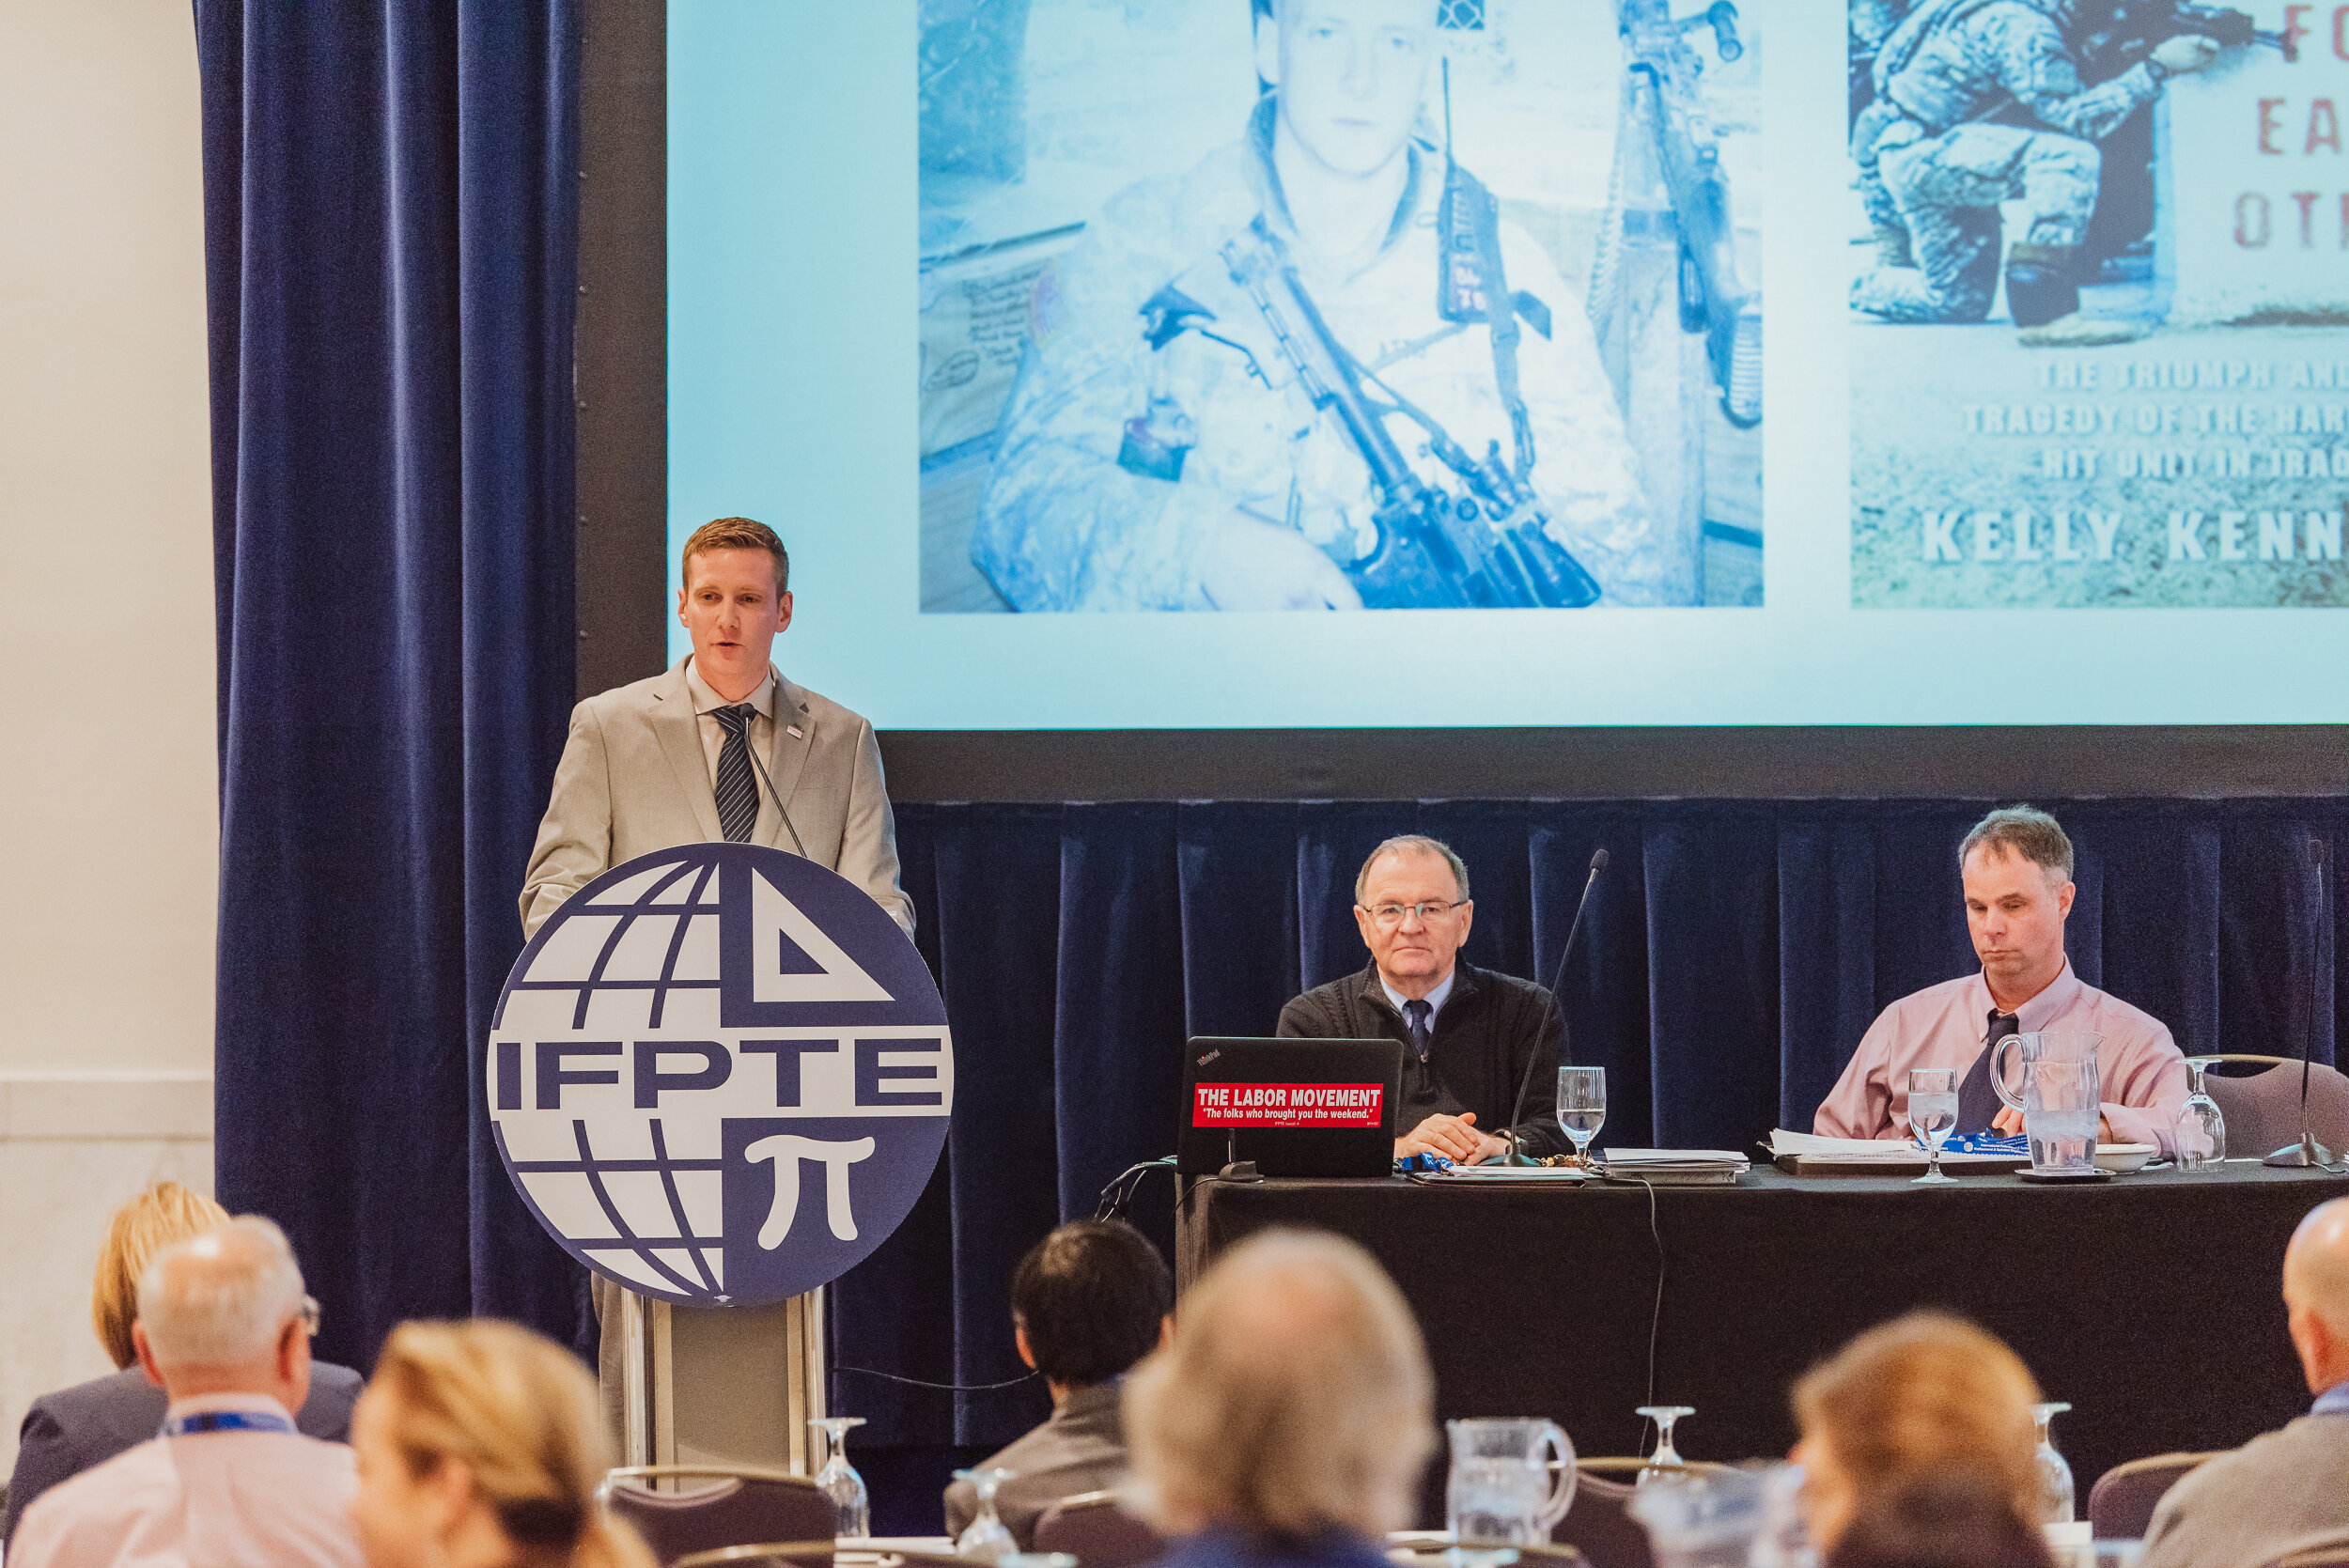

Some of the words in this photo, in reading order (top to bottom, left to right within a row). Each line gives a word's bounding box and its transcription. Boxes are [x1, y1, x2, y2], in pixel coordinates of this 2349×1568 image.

[2258, 98, 2341, 155] EA
[2233, 192, 2349, 250] OT
[2035, 360, 2097, 388] THE
[2116, 360, 2271, 389] TRIUMPH
[1963, 404, 2119, 433] TRAGEDY
[2137, 404, 2181, 433] OF
[2197, 404, 2257, 433] THE
[2118, 449, 2199, 478] UNIT
[2216, 449, 2251, 478] IN
[1922, 510, 2123, 561] KELLY
[2166, 510, 2343, 561] KENN
[496, 1037, 942, 1110] IFPTE
[1198, 1089, 1229, 1106] THE
[1234, 1089, 1286, 1106] LABOR
[1291, 1089, 1380, 1107] MOVEMENT
[1223, 1108, 1244, 1118] folks
[1246, 1109, 1263, 1118] who
[1265, 1108, 1296, 1121] brought
[1298, 1110, 1313, 1121] you
[1315, 1108, 1328, 1119] the
